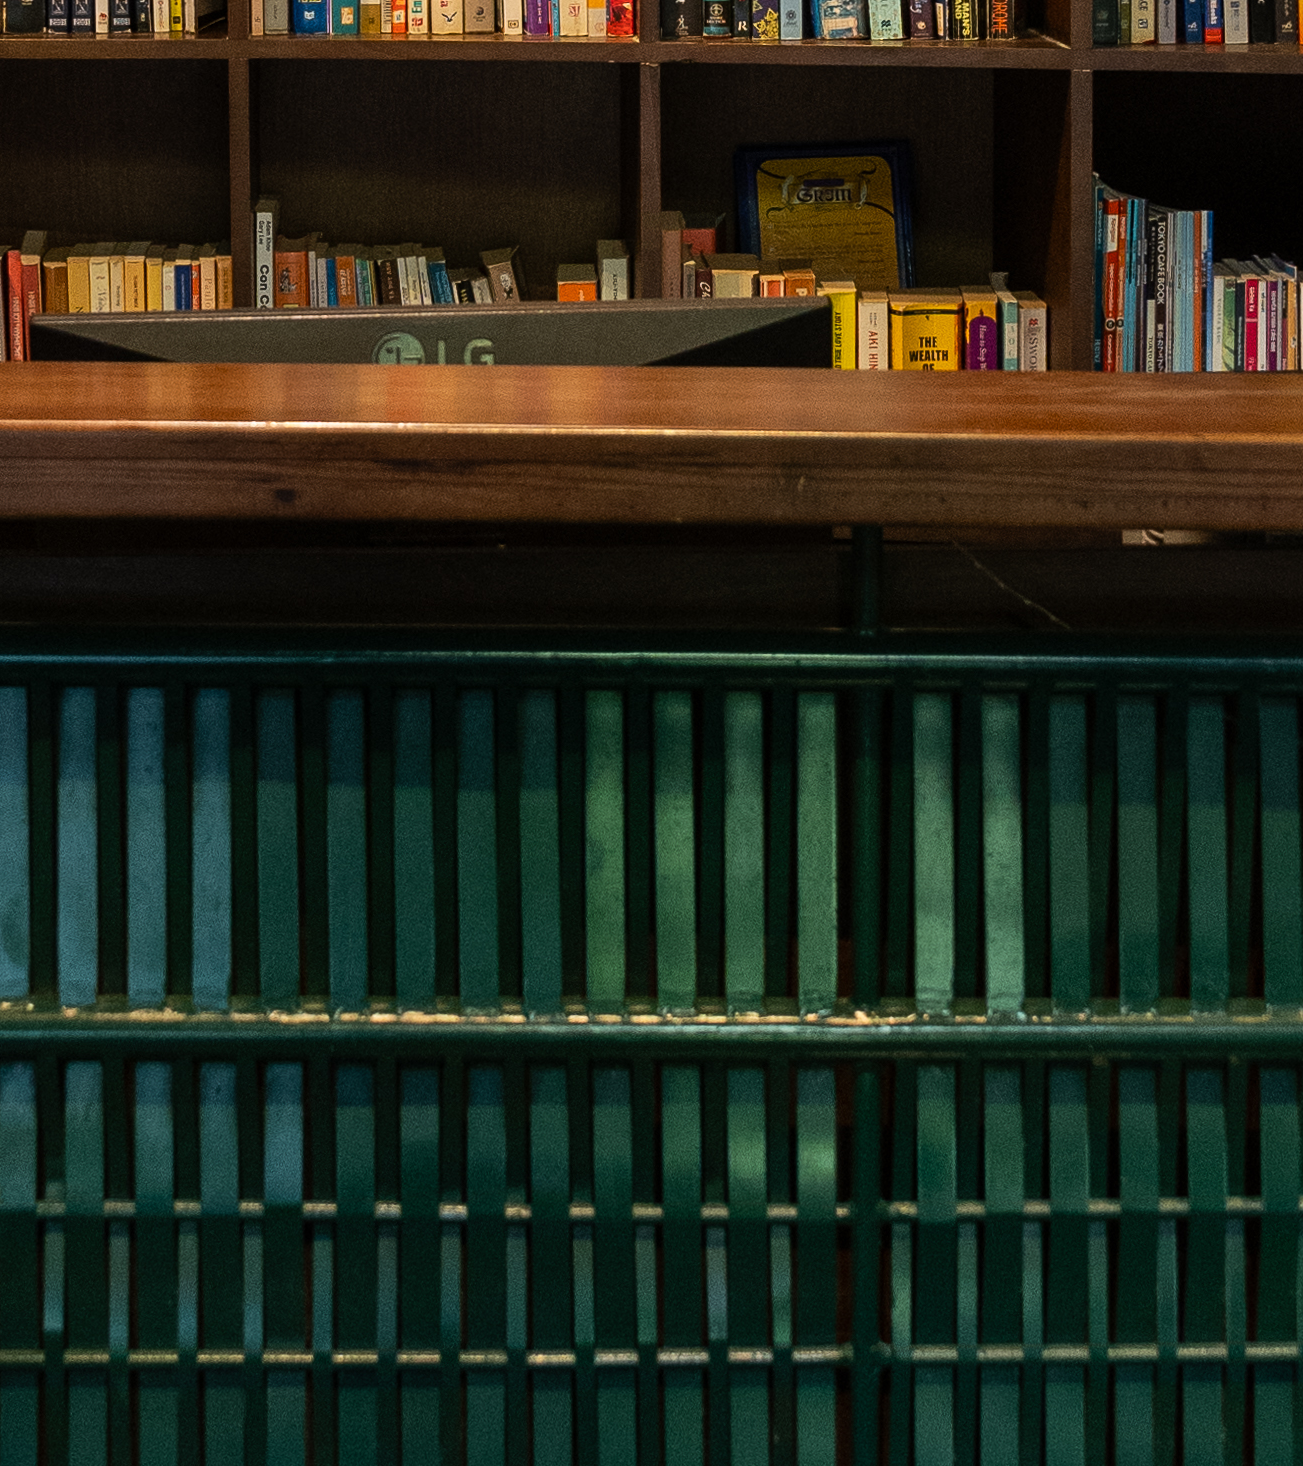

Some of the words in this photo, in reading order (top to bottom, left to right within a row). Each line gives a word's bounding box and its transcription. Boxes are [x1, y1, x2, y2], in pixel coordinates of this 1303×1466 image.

[960, 3, 970, 36] MAN'S
[1157, 221, 1168, 252] TOKYO
[1157, 254, 1168, 277] CAFE
[1157, 278, 1168, 305] BOOK
[834, 311, 843, 333] STORY
[918, 336, 938, 349] THE
[909, 349, 949, 362] WEALTH
